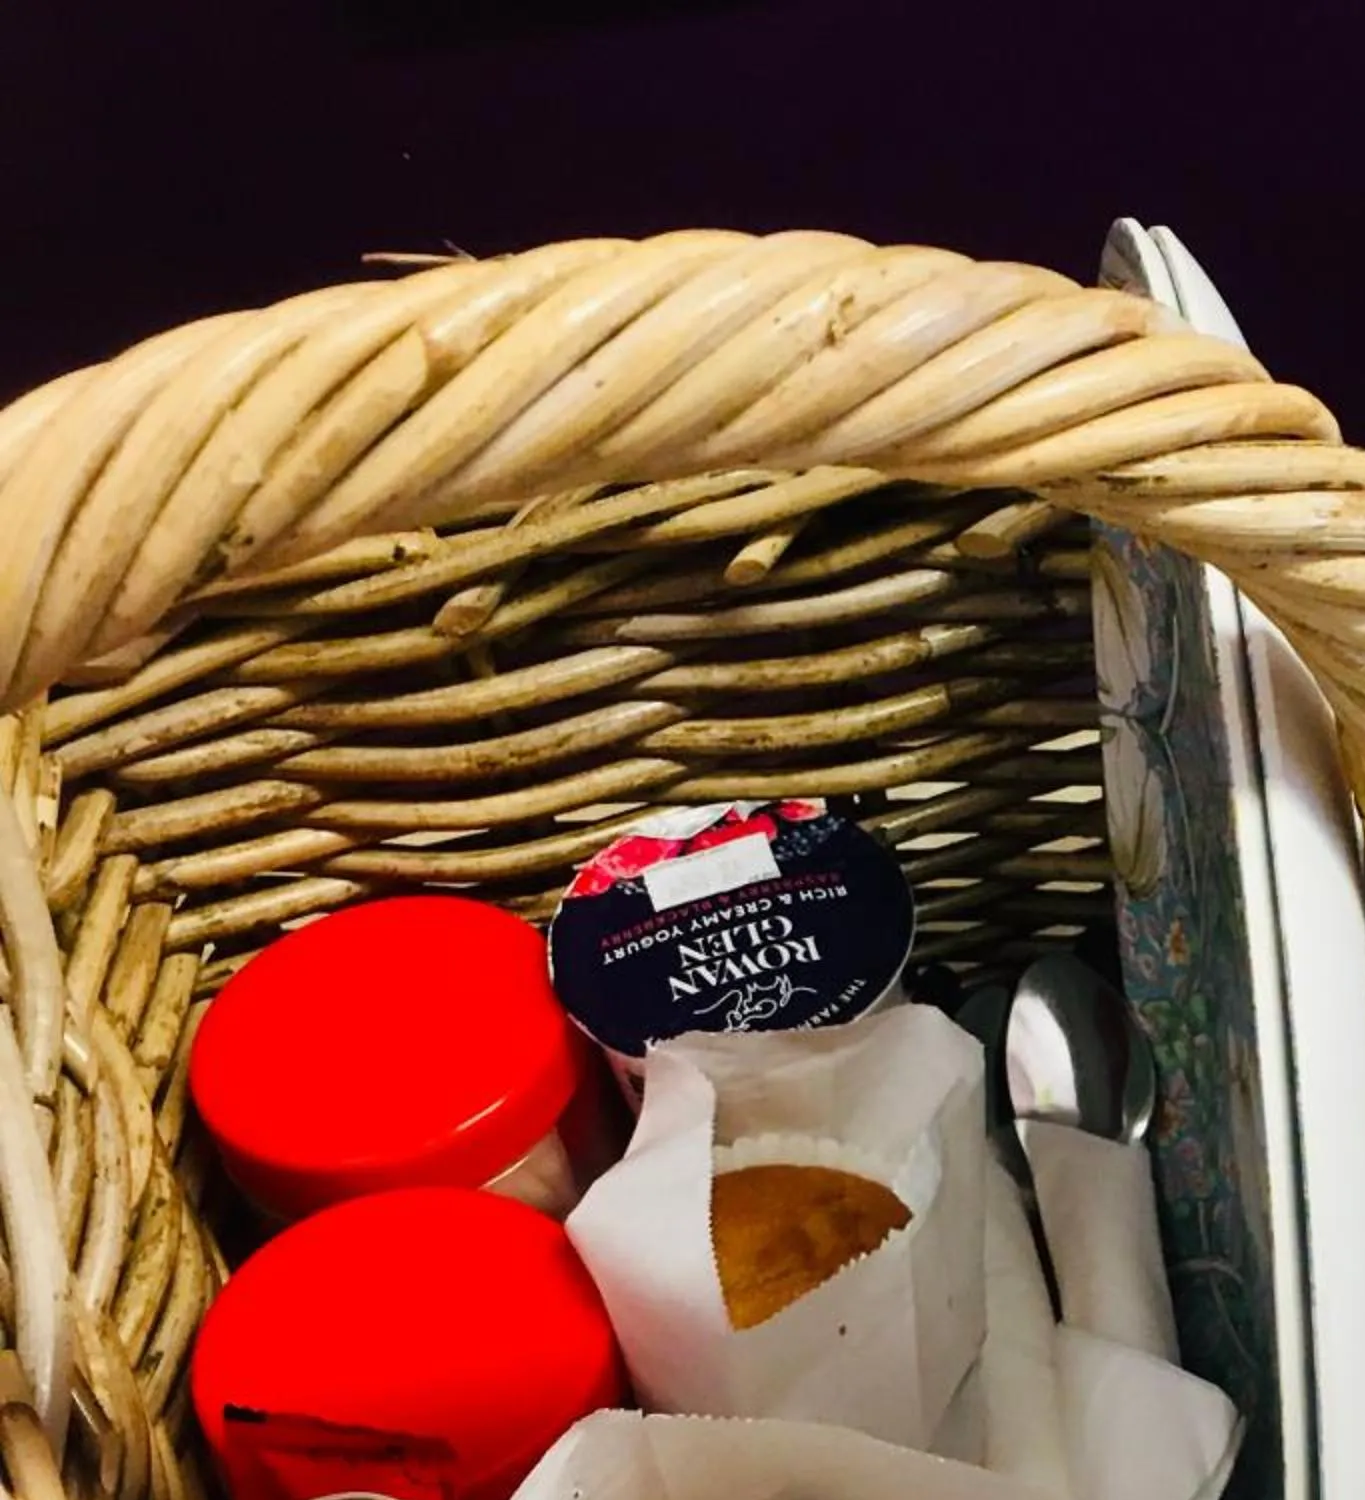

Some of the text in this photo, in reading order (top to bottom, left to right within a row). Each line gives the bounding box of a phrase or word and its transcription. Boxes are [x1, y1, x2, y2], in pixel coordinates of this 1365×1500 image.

[603, 884, 848, 966] RICH & CREAMY YOGURT
[678, 914, 793, 970] GLEN
[669, 934, 822, 1002] ROWAN
